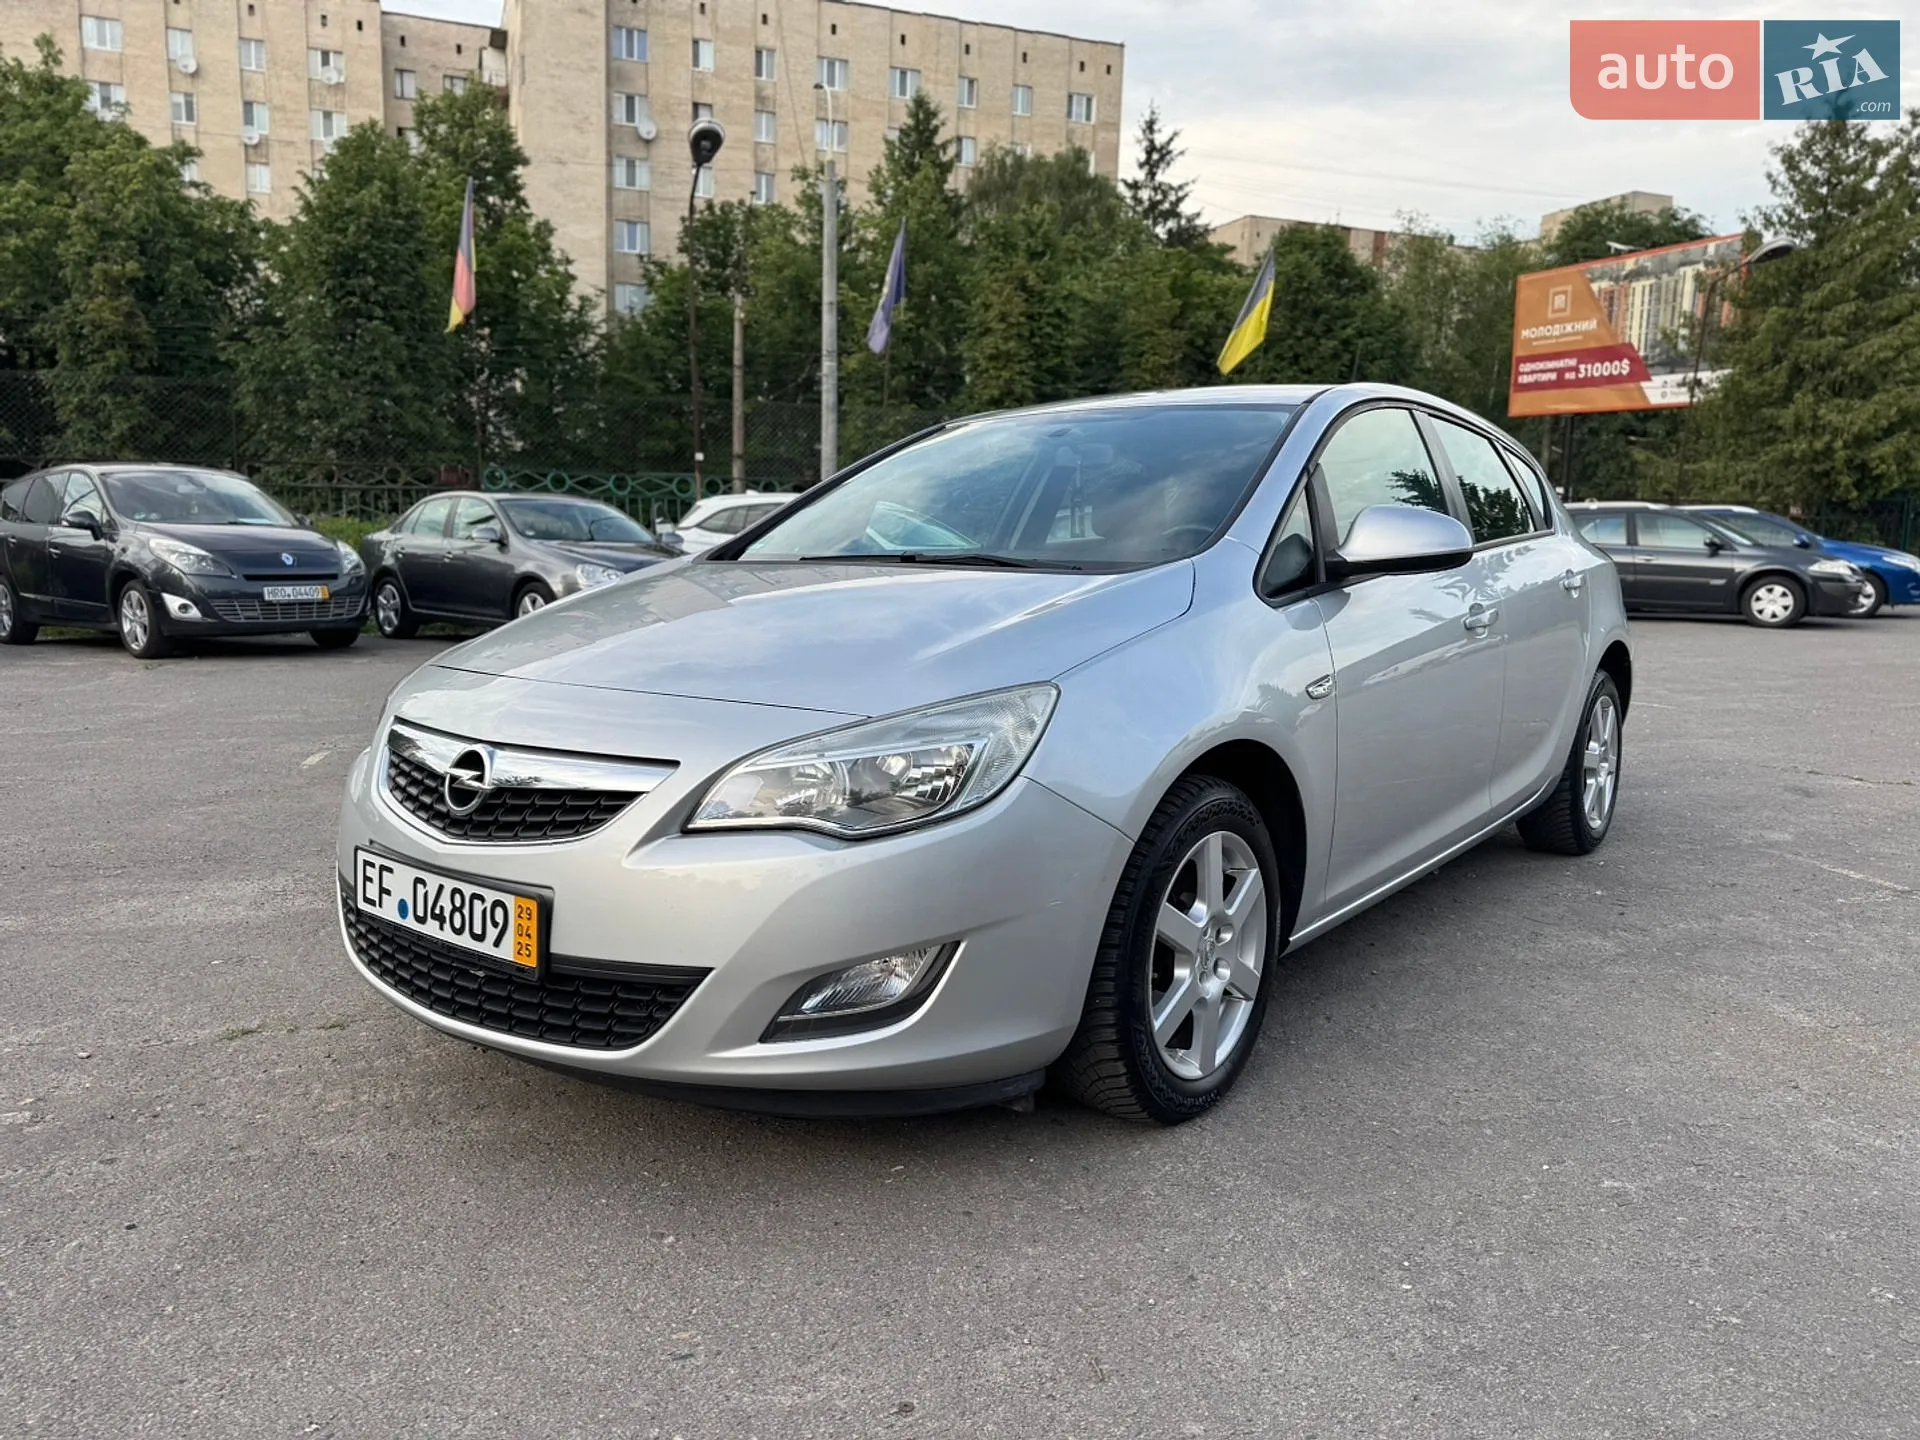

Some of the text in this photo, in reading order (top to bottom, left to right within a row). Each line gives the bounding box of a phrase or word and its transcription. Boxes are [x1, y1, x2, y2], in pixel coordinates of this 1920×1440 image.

[1521, 318, 1598, 339] МОЛОДІЖНИЙ
[1577, 358, 1631, 379] 31000$
[362, 858, 509, 948] EF 04809
[517, 904, 533, 921] 29
[517, 924, 532, 940] 04
[516, 941, 532, 958] 25
